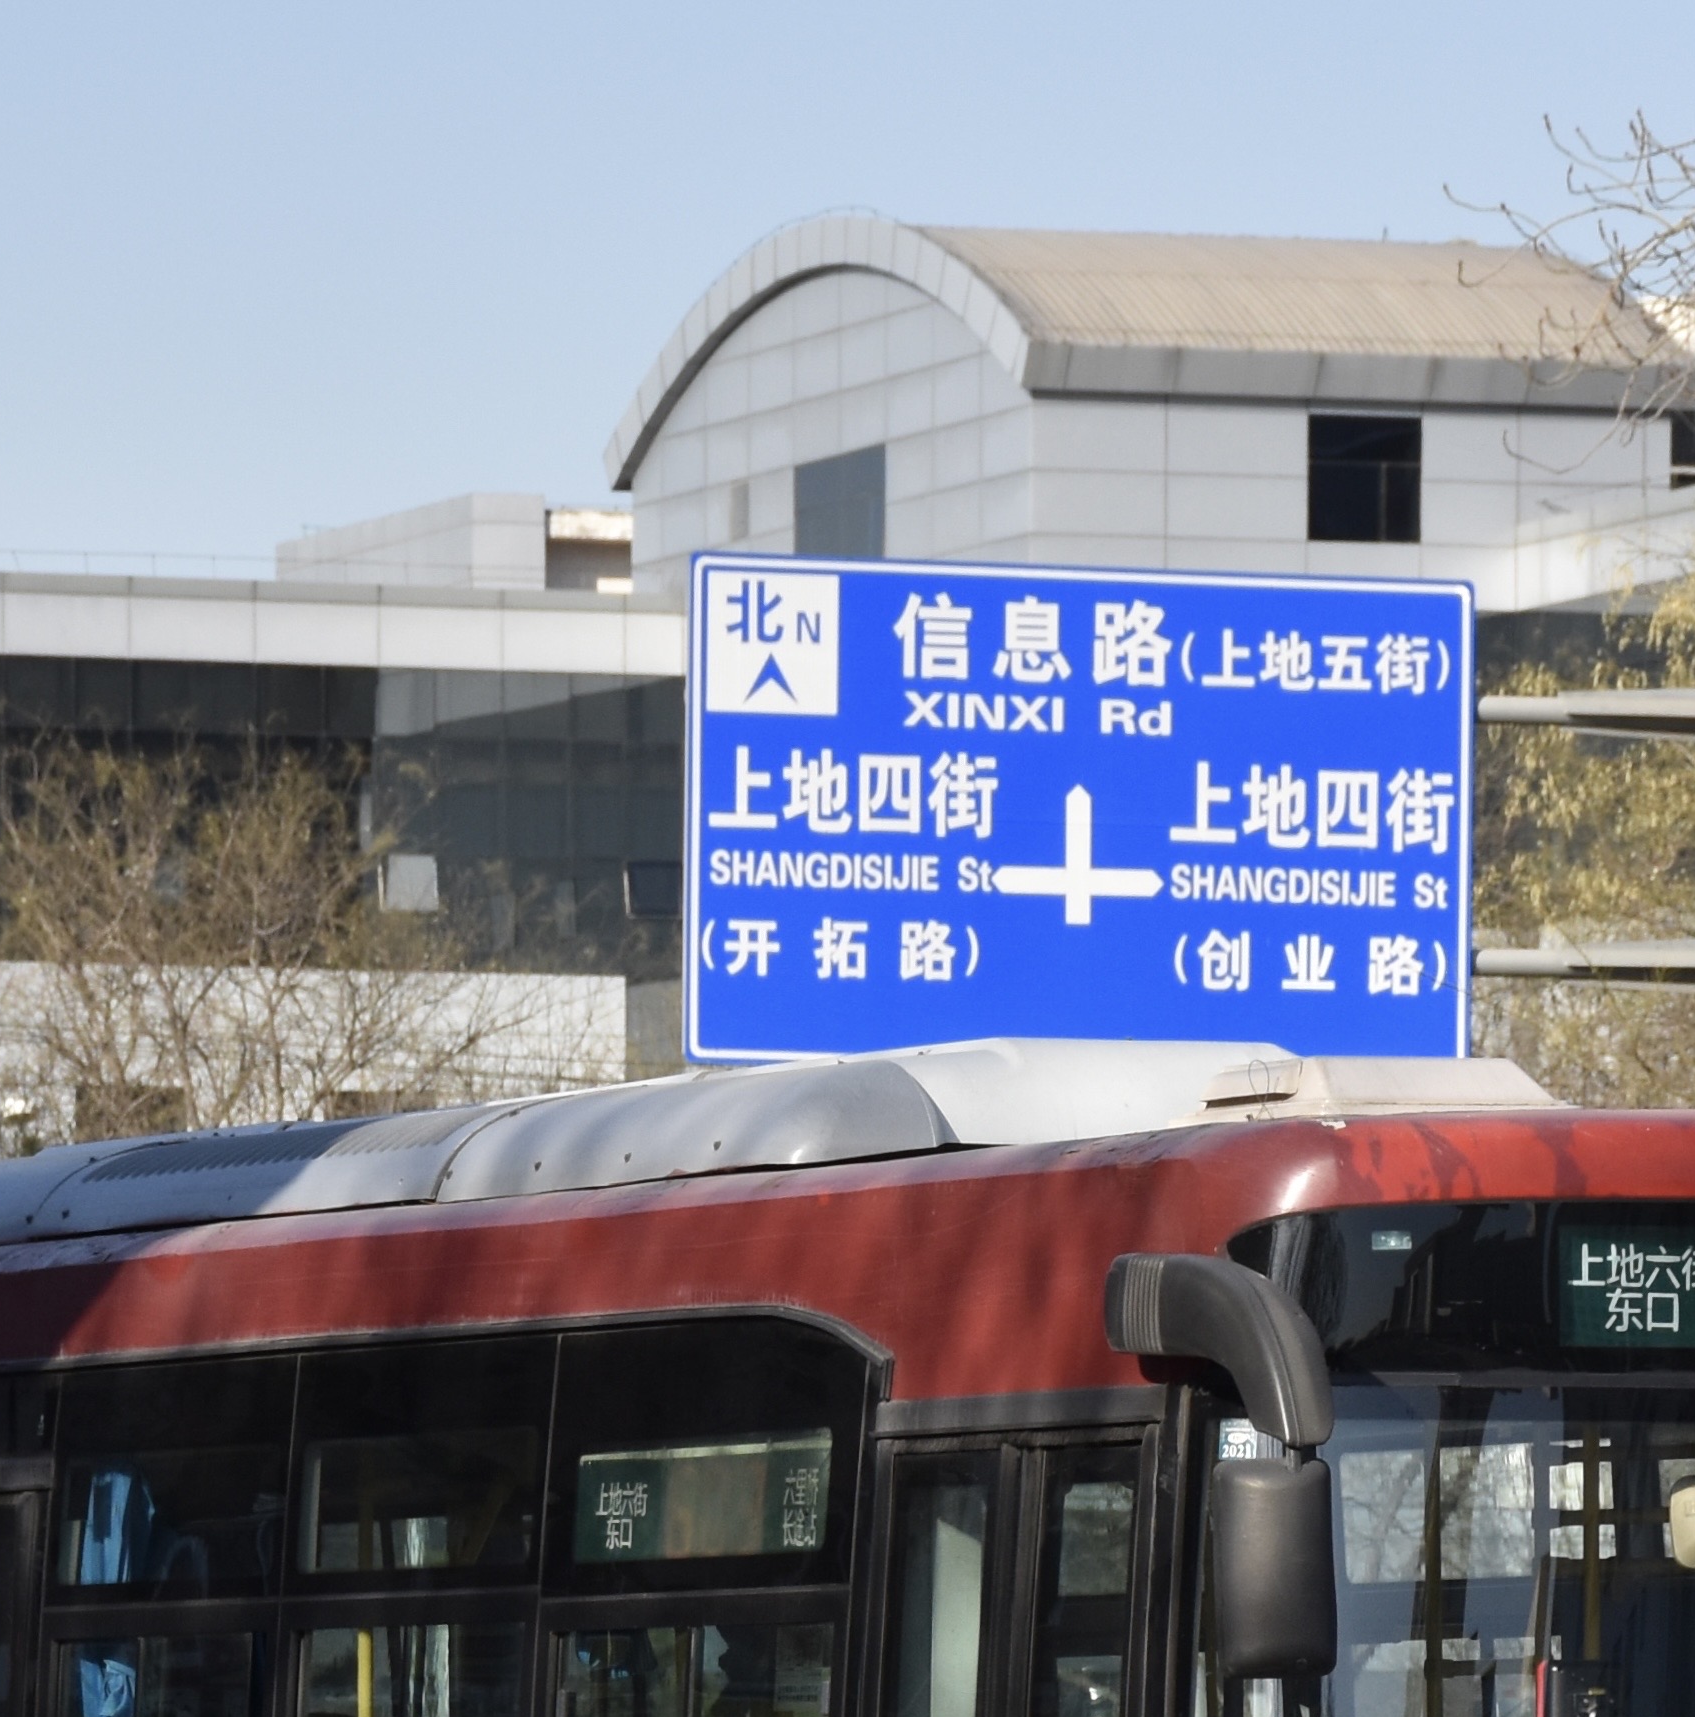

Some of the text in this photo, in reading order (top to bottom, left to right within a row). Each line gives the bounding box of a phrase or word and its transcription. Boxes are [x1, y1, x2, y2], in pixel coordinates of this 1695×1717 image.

[726, 580, 821, 644] 北 N
[893, 592, 1451, 695] 信息路 (上地五街)
[903, 691, 1173, 737] XINXI Rd
[708, 744, 999, 838] 上地四街
[1169, 760, 1454, 855] 上地四街
[709, 848, 993, 894] SHANGDISIJIE St
[1170, 863, 1448, 910] SHANGDISIJIE St
[700, 917, 981, 982] (开拓路)
[1173, 928, 1448, 997] (创业路)
[1605, 1288, 1679, 1333] 东口
[1222, 1444, 1252, 1459] 2021
[595, 1482, 648, 1518] 上地六街
[605, 1518, 633, 1550] 东口
